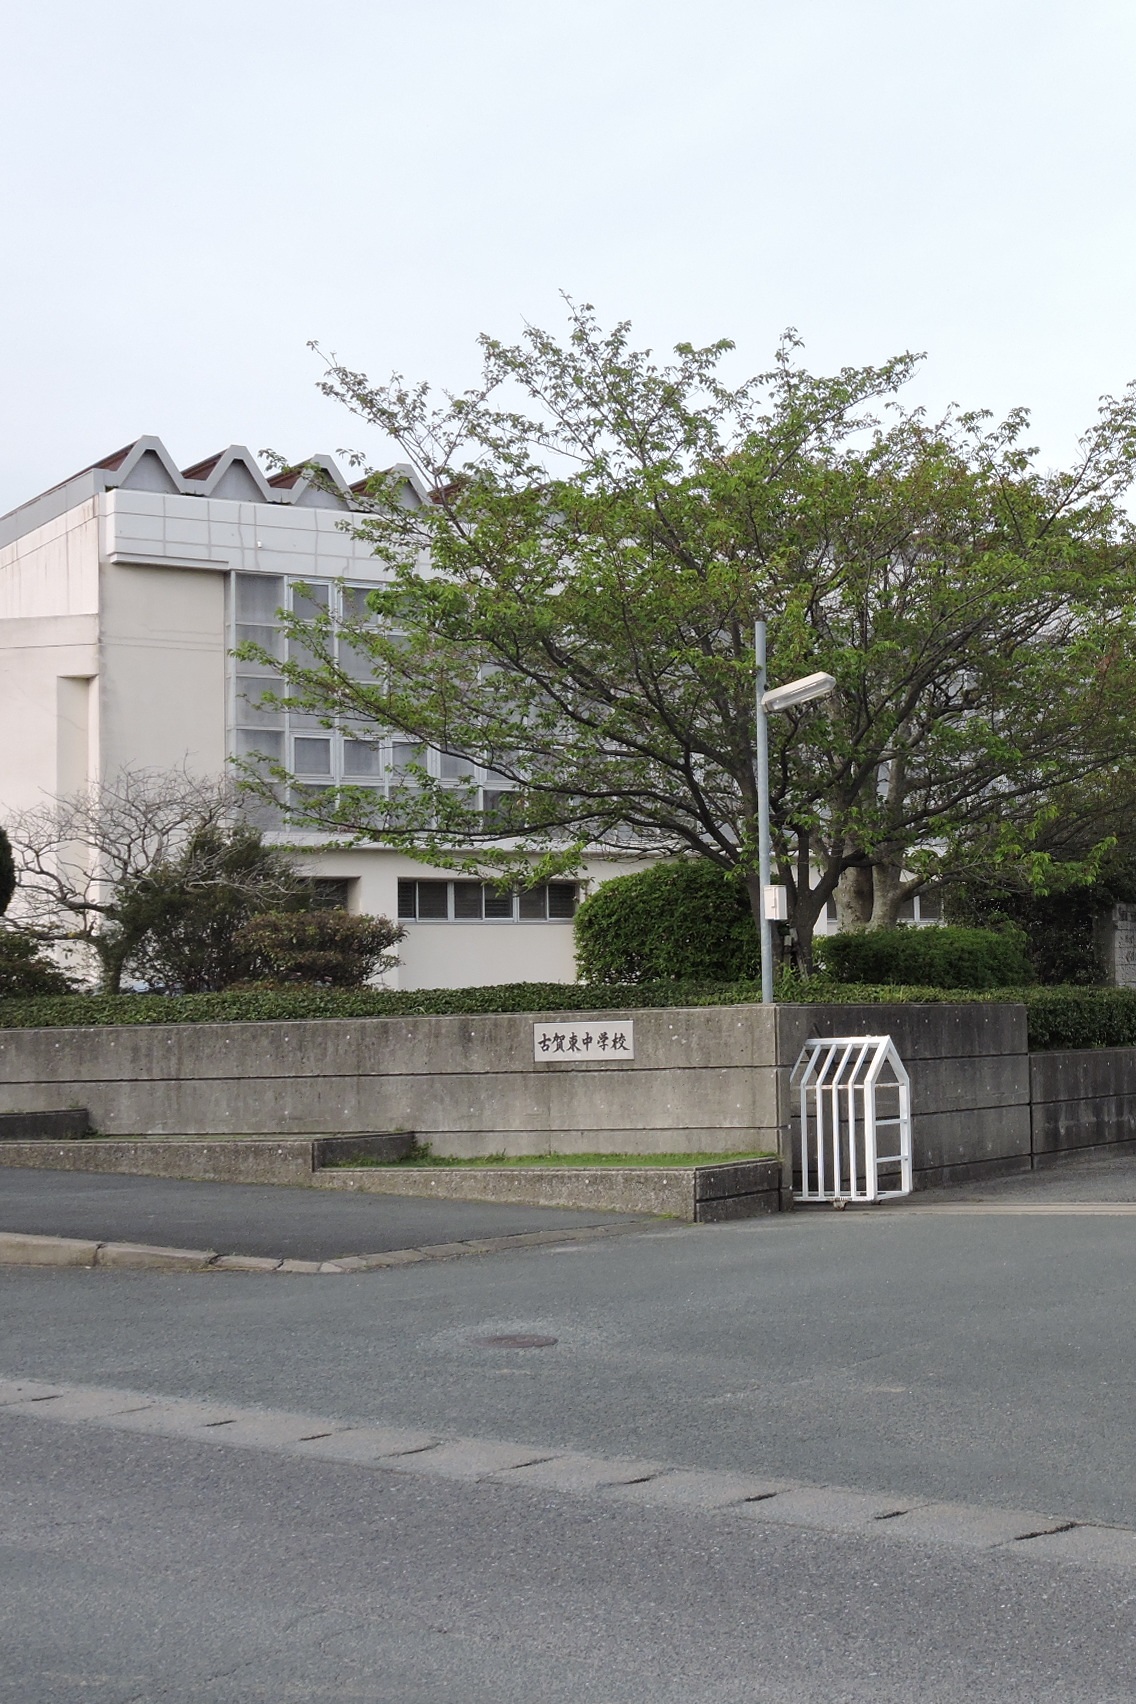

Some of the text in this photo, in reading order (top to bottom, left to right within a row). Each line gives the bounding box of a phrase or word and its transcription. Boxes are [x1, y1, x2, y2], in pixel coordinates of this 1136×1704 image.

[537, 1031, 631, 1054] 古賀東中学校
